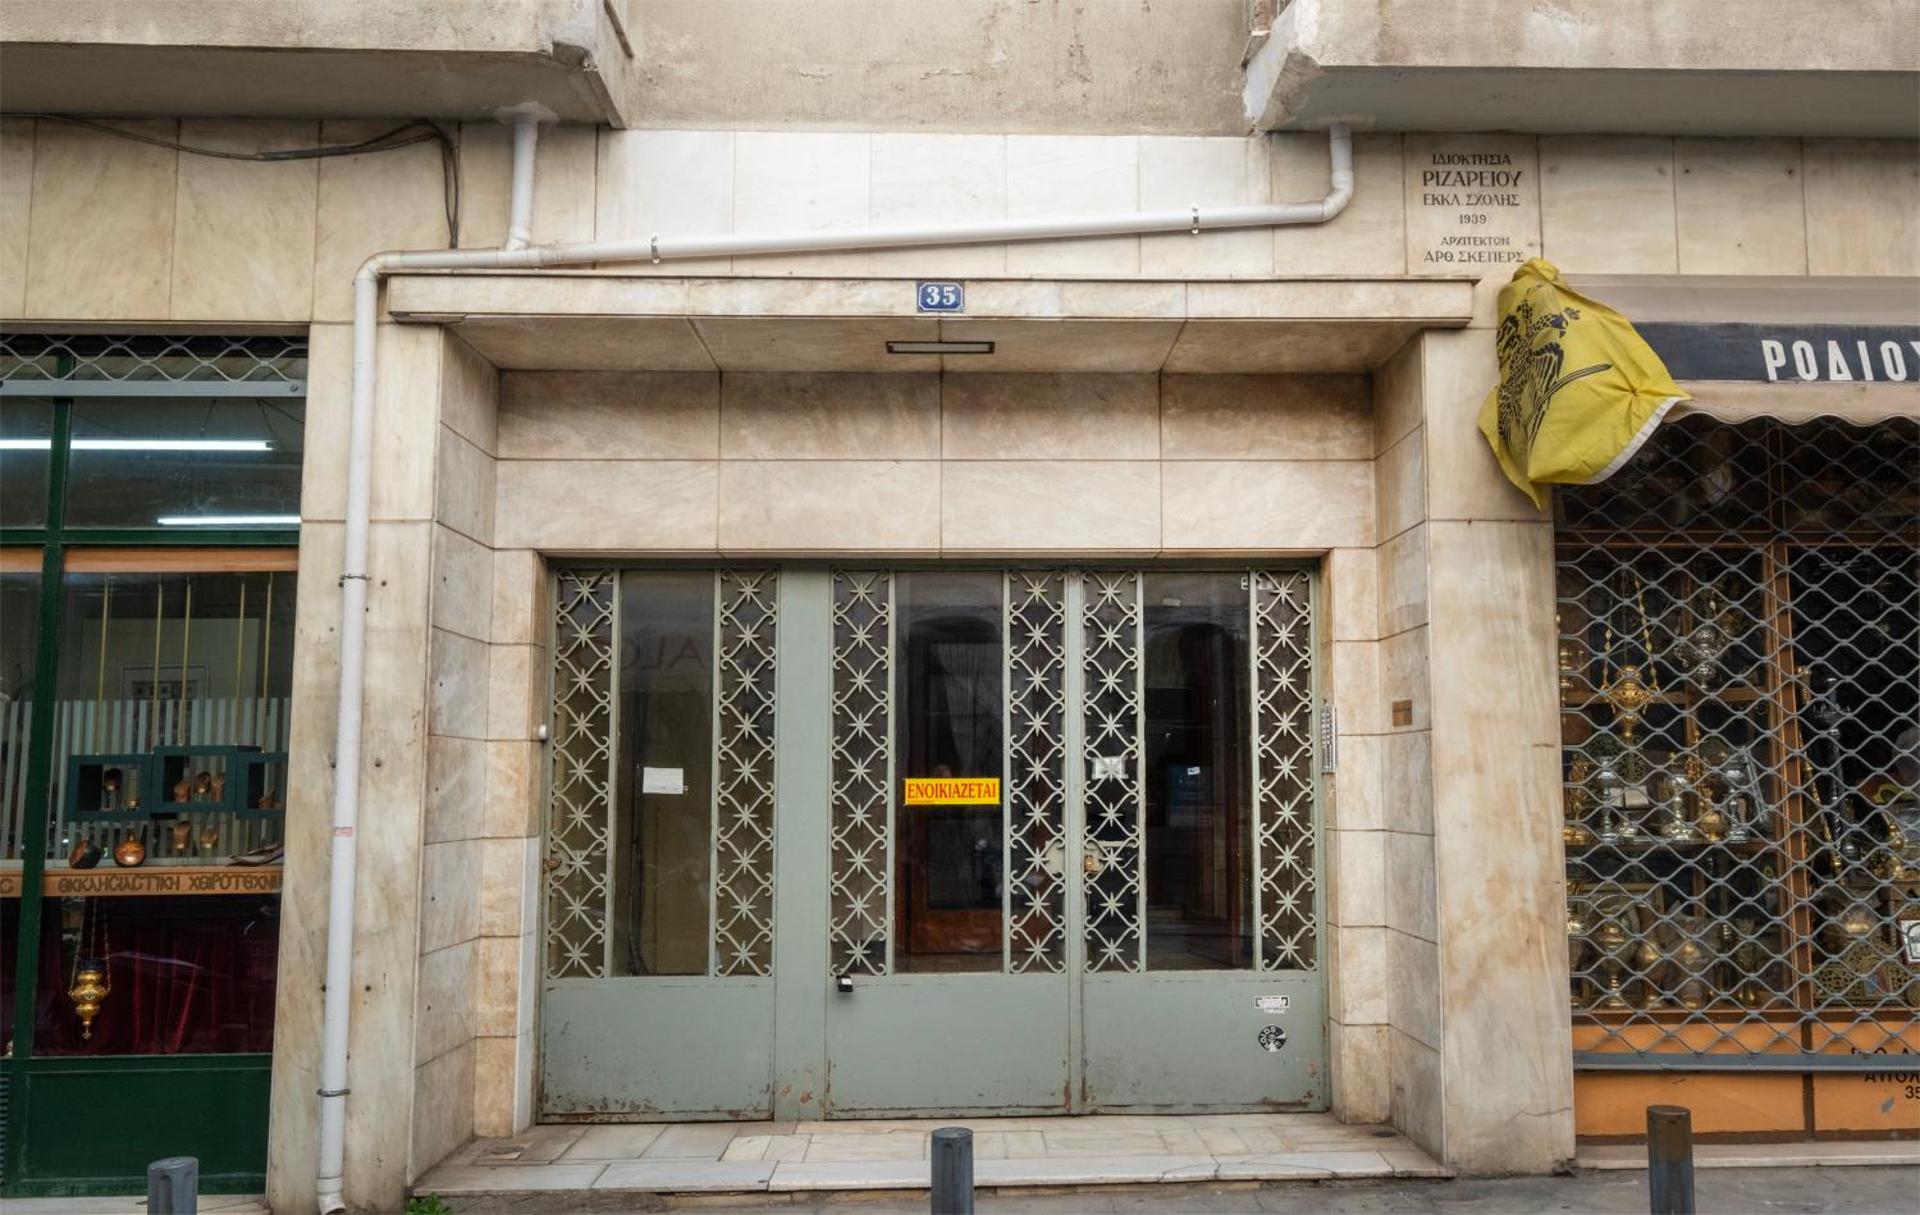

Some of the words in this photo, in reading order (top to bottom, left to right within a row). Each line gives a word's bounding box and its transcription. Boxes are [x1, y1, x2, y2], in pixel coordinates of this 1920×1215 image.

[1432, 153, 1512, 166] ΙΔΙΟΚΤΗΣΙΑ
[1422, 170, 1523, 187] ΡΙΖΑΡΕΙΟΥ
[1466, 194, 1520, 207] ΣΧΟΛΗΣ
[1459, 214, 1487, 225] 1939
[926, 286, 956, 306] 35
[908, 782, 996, 799] ΕΝΟΙΚΙΑΖΕΤΑΙ
